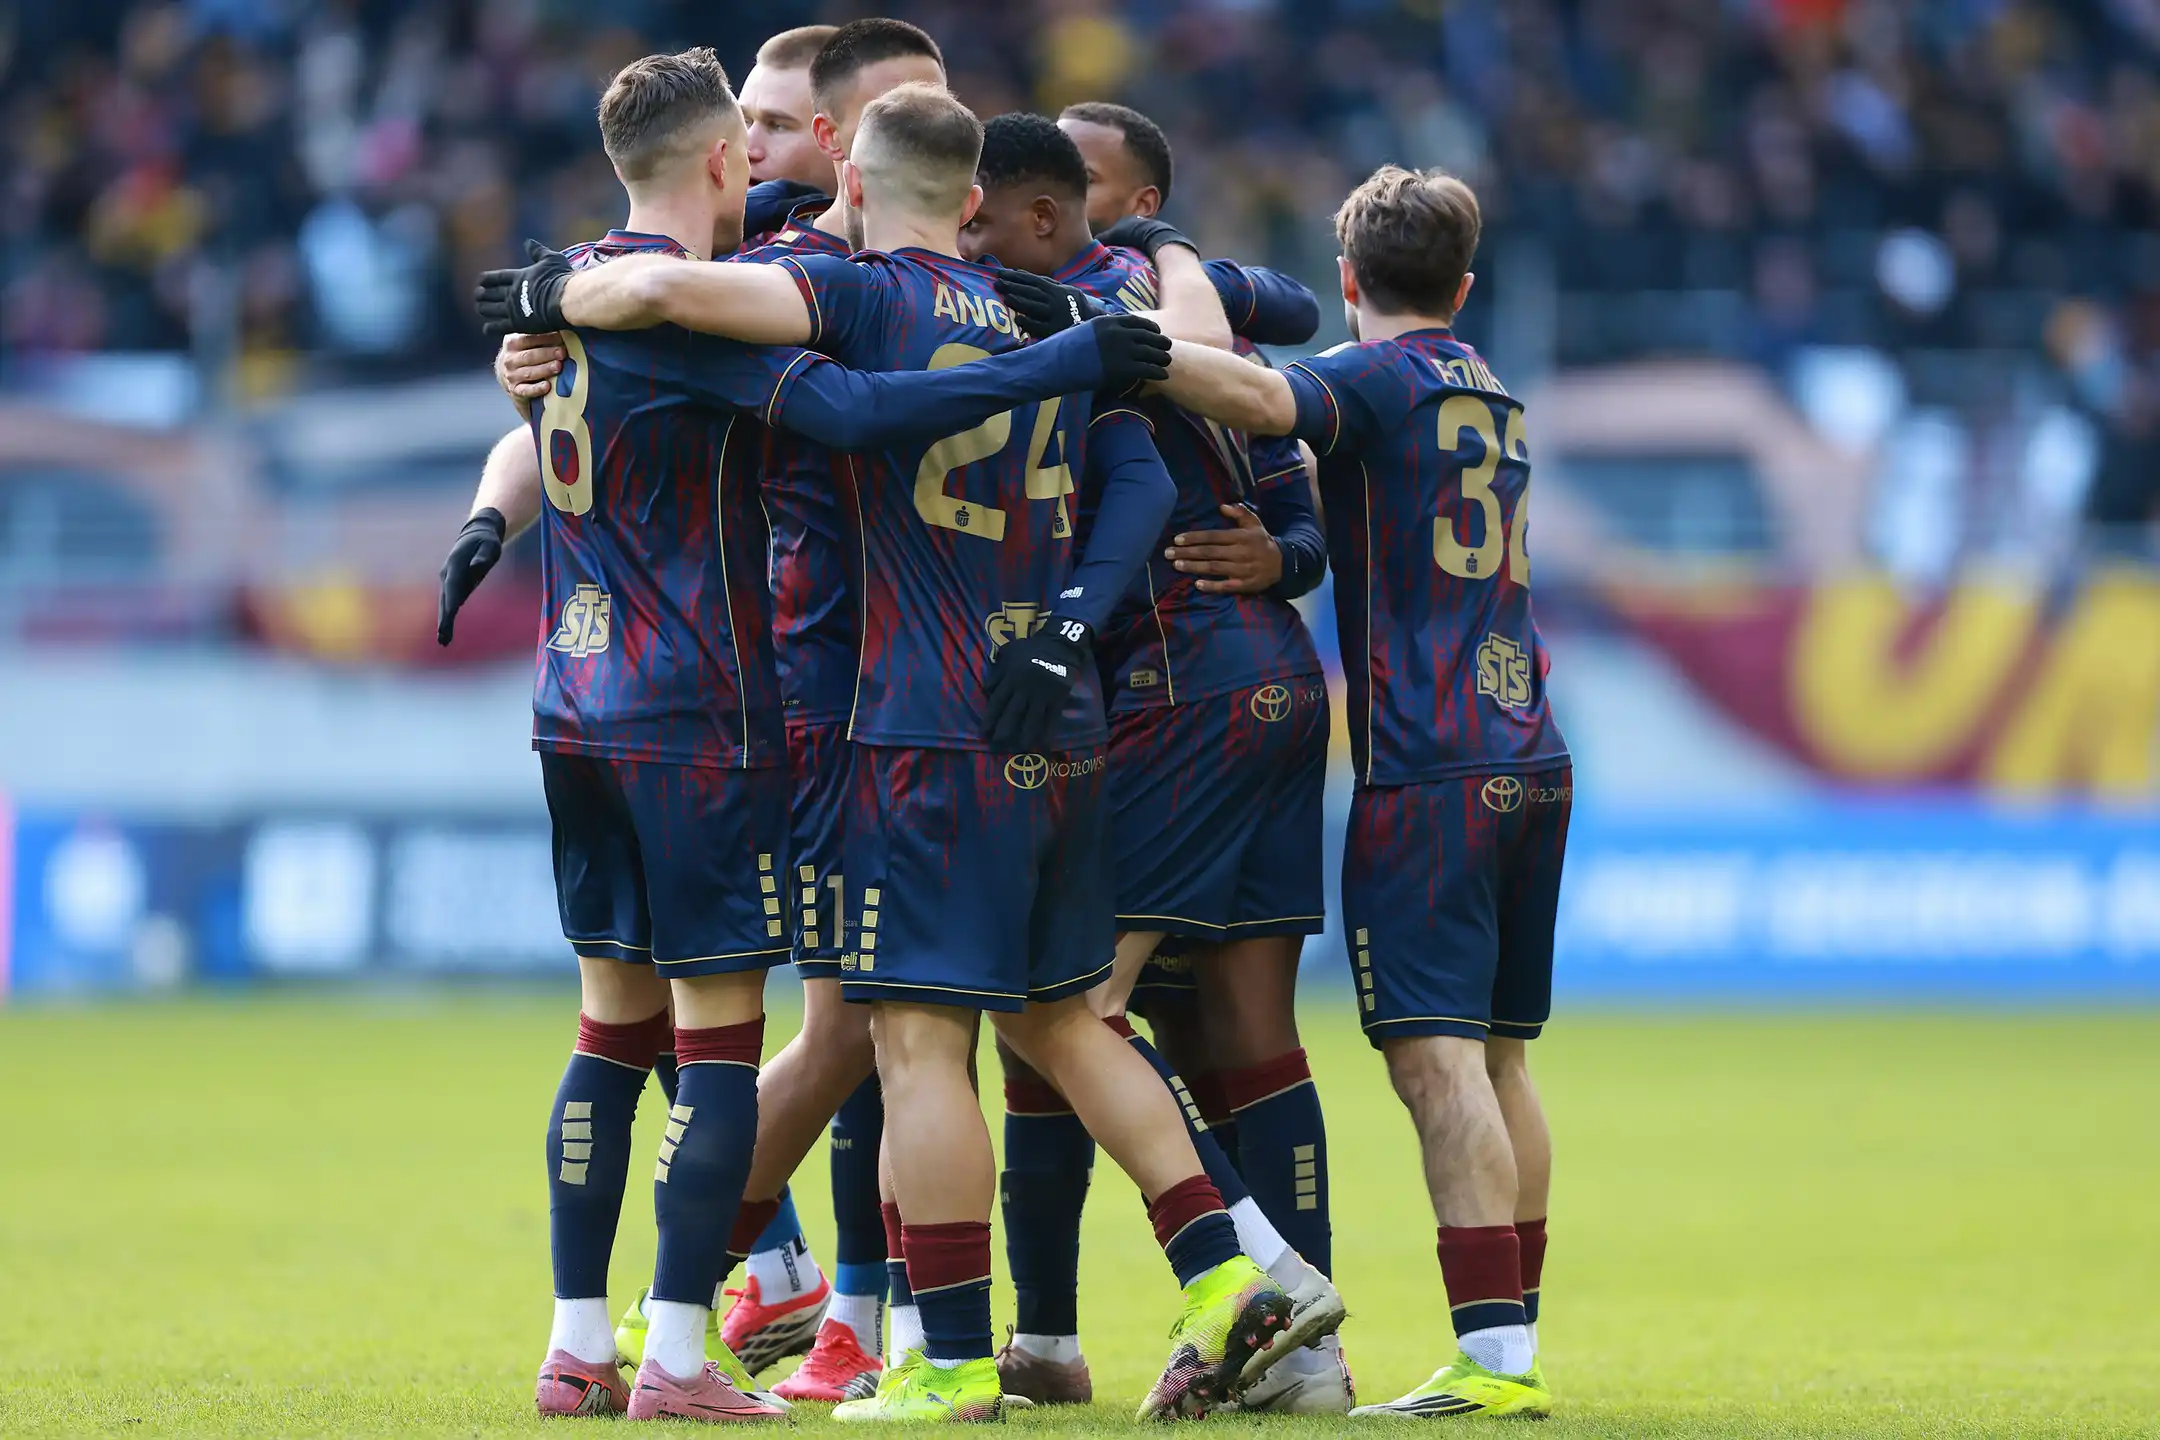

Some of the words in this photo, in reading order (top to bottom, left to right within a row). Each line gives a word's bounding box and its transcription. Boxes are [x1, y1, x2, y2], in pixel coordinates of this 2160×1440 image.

[540, 330, 593, 516] 8
[913, 342, 1075, 541] 24
[1433, 395, 1531, 590] 32
[546, 583, 612, 658] STS
[1059, 620, 1086, 643] 18
[1476, 631, 1532, 709] STS
